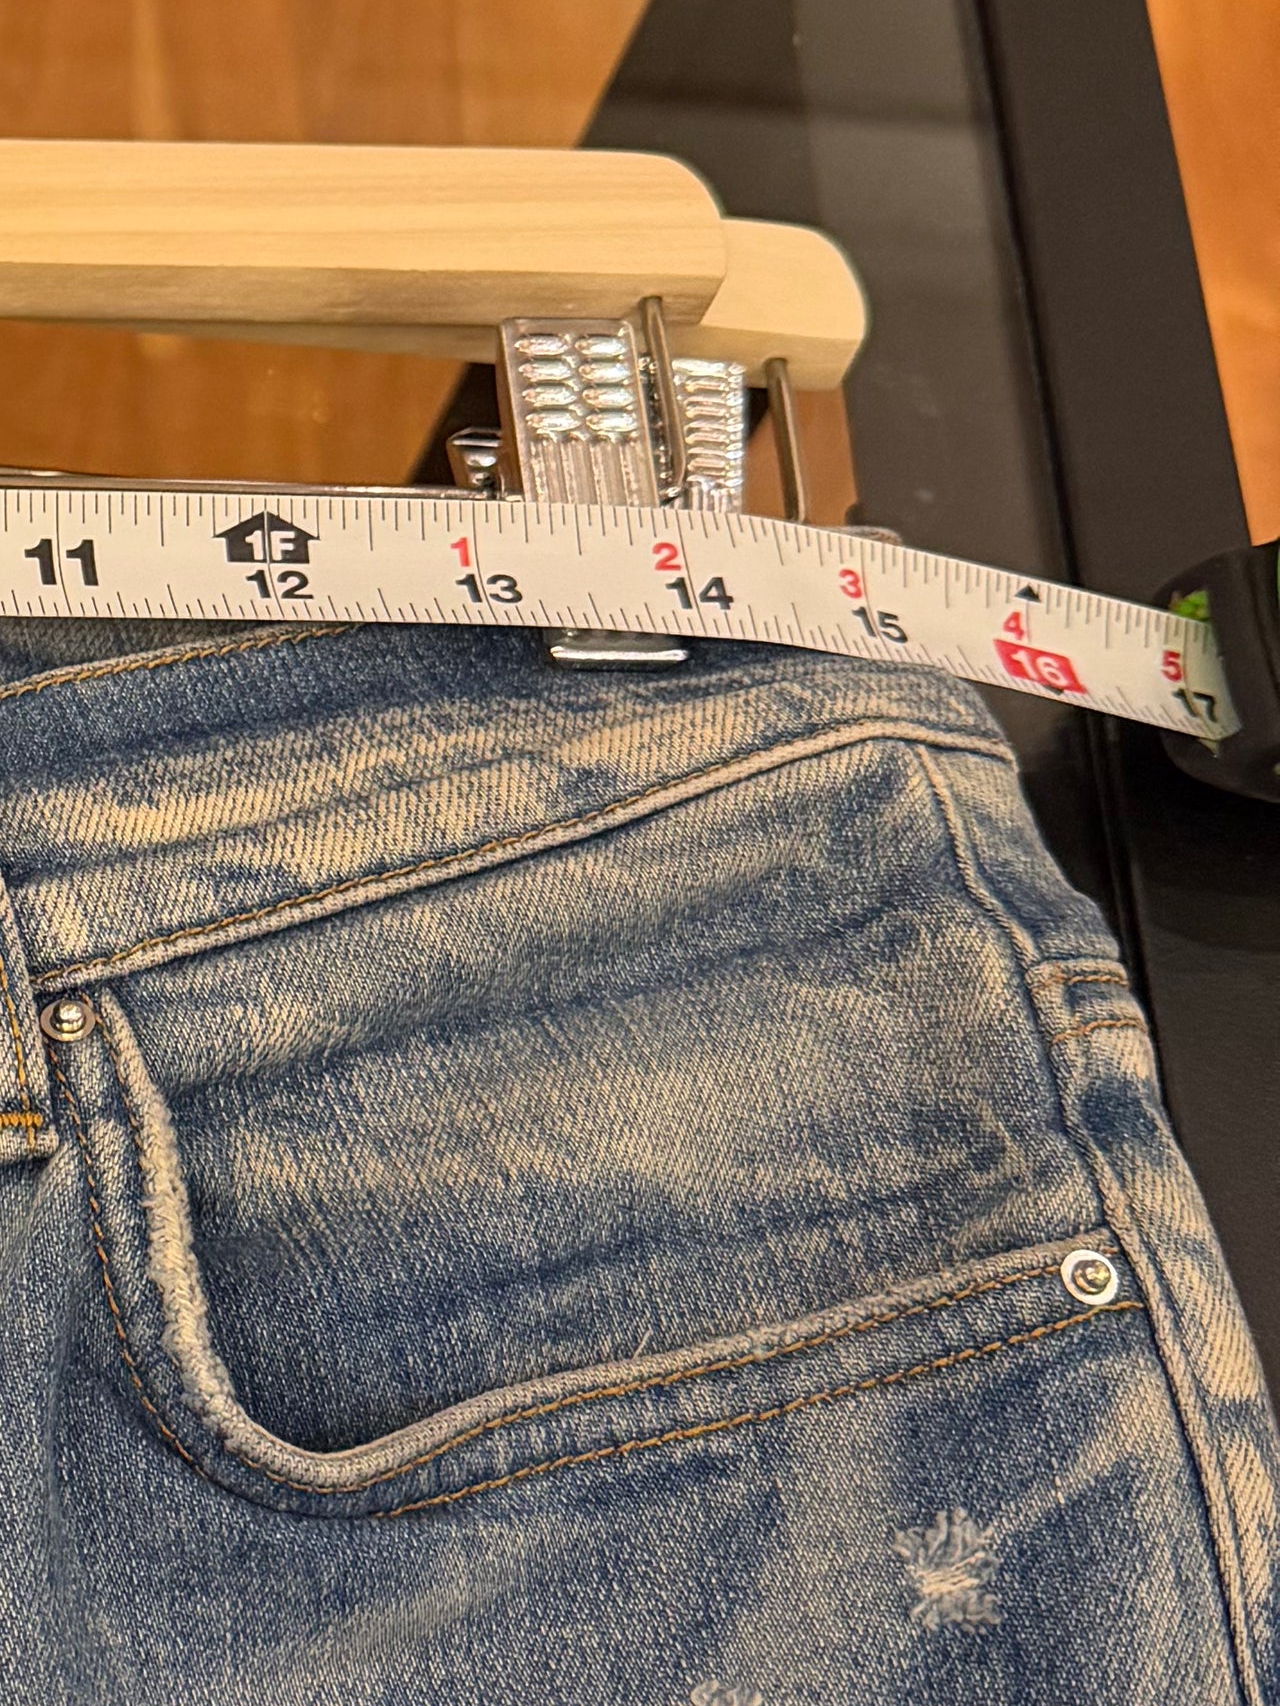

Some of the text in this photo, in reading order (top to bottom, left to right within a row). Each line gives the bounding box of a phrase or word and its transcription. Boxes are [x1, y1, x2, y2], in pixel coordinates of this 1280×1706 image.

[24, 537, 100, 587] 11
[450, 537, 470, 567] 1
[651, 541, 682, 571] 2
[838, 568, 864, 601] 3
[1002, 610, 1025, 641] 4
[244, 570, 1218, 724] 12 13 14 15 16 17
[1160, 651, 1183, 682] 5
